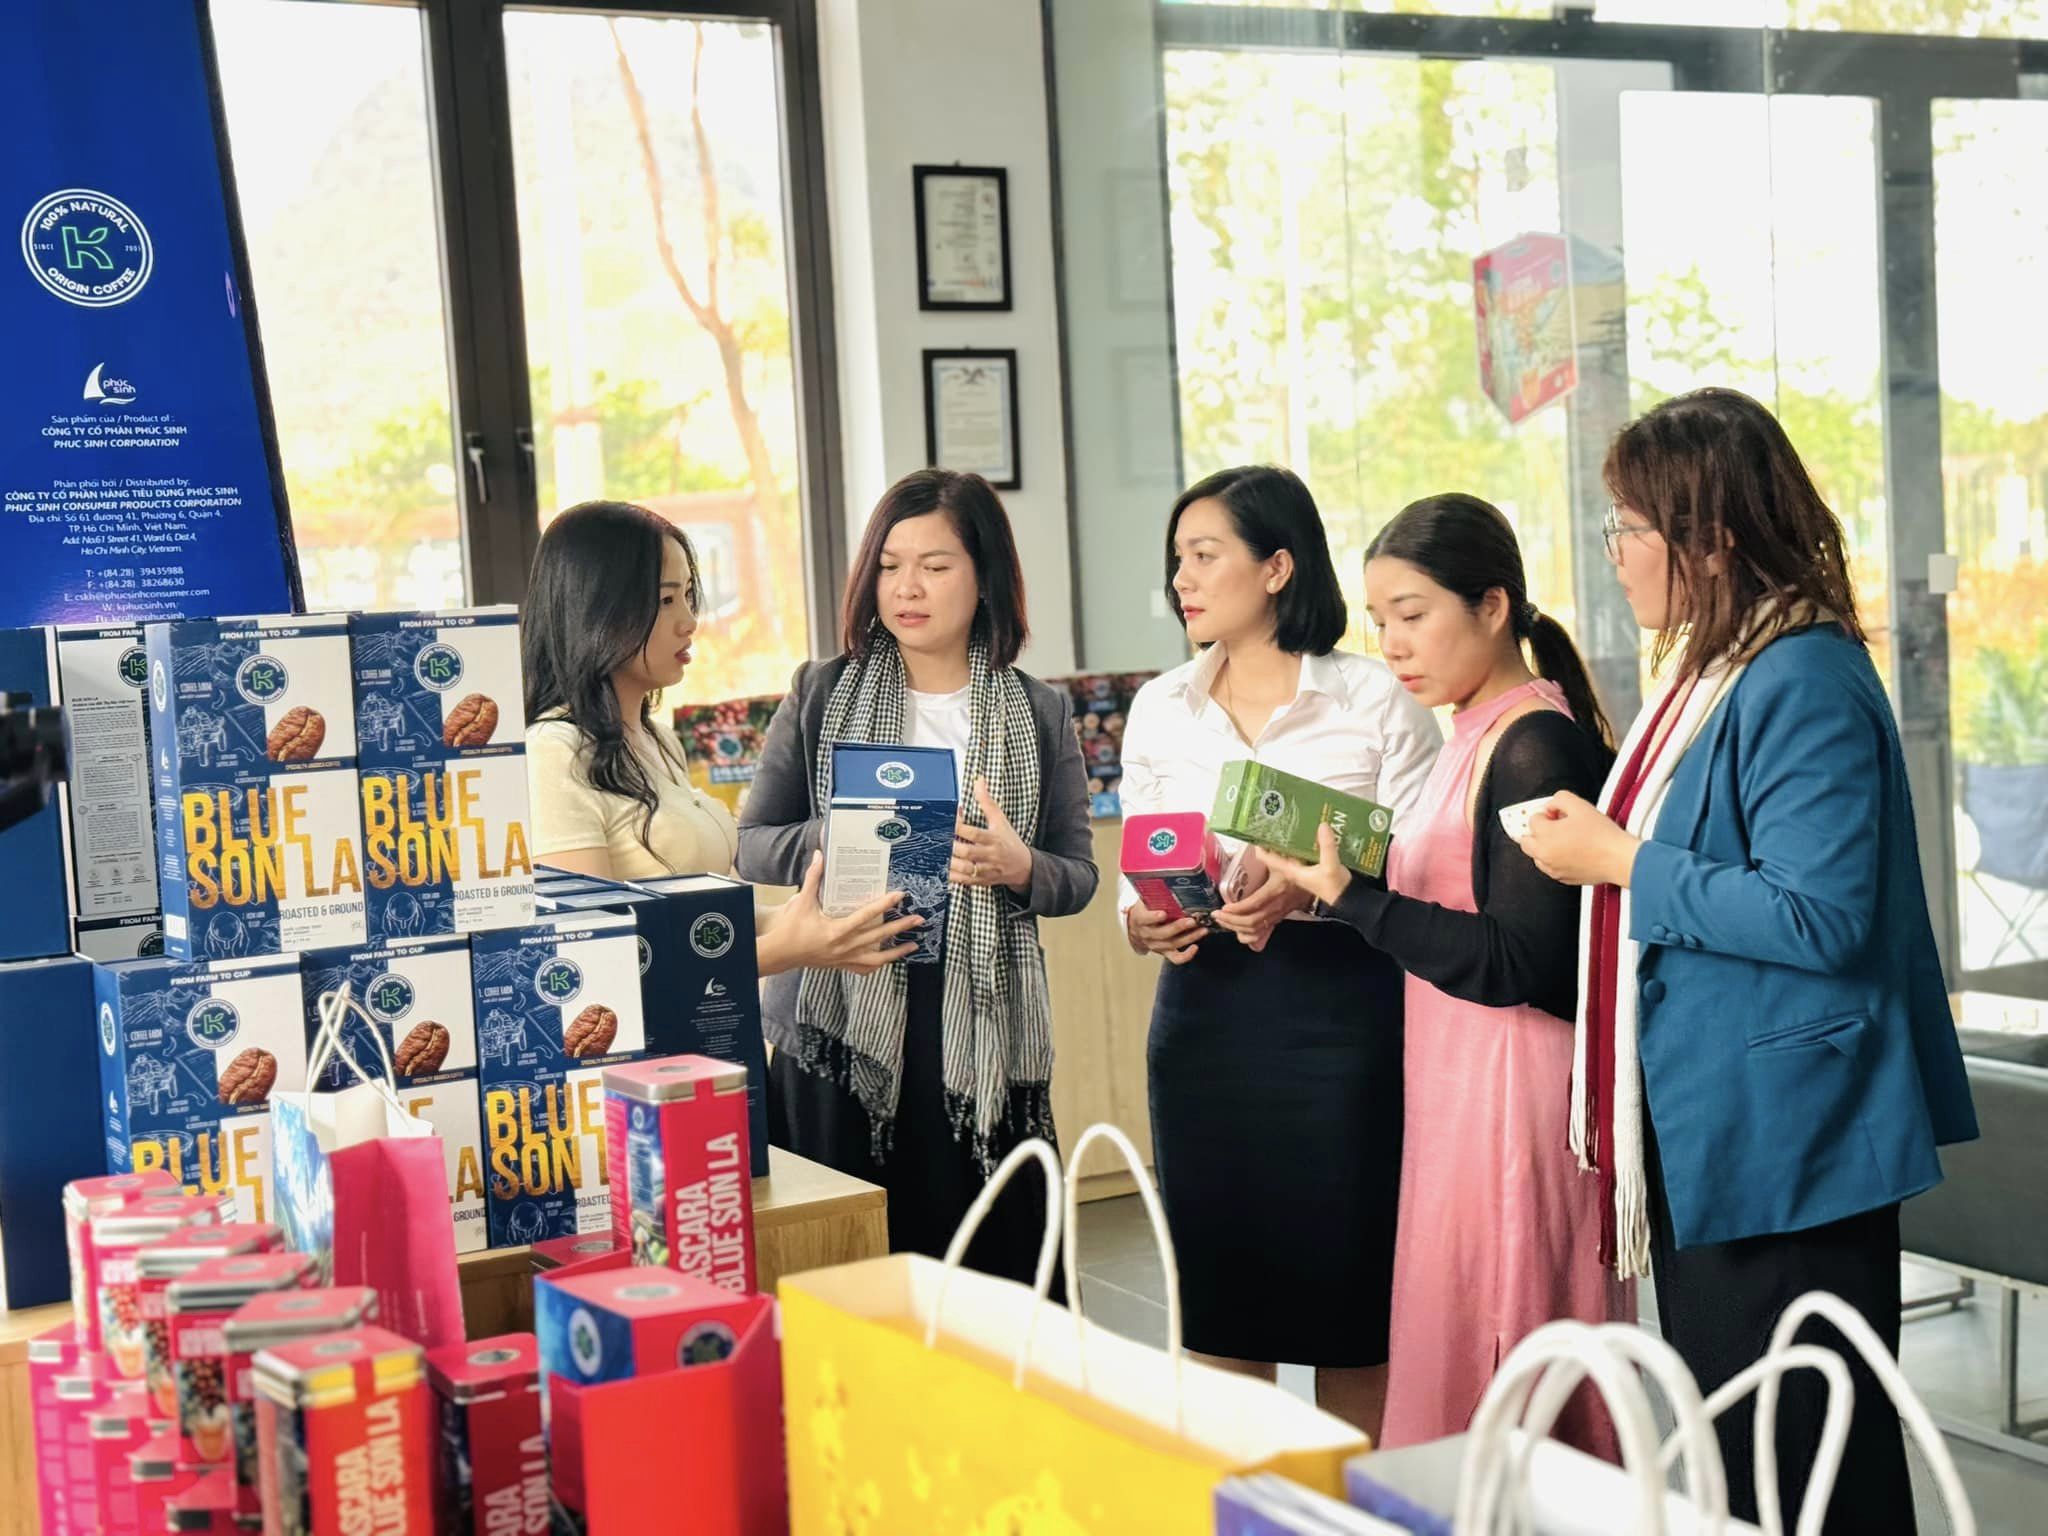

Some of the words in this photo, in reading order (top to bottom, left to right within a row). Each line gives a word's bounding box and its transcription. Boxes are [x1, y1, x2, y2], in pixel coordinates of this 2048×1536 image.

[40, 204, 69, 231] 100%
[70, 201, 129, 234] NATURAL
[48, 267, 90, 295] ORIGIN
[93, 267, 136, 295] COFFEE
[103, 378, 128, 390] phúc
[113, 384, 136, 393] sinh
[123, 414, 158, 424] Product
[41, 425, 71, 437] CÔNG
[73, 426, 86, 436] TY
[163, 425, 187, 435] SINH
[54, 439, 81, 449] PHUC
[83, 439, 108, 449] SINH
[110, 437, 179, 448] CORPORATION
[125, 478, 174, 487] Distributed
[5, 490, 35, 501] CÔNG
[37, 491, 50, 500] TY
[215, 486, 238, 496] SINH
[4, 503, 34, 512] PHUC
[35, 503, 60, 512] SINH
[62, 501, 118, 511] CONSUMER
[119, 499, 172, 510] PRODUCTS
[173, 497, 242, 508] CORPORATION
[79, 512, 91, 522] 61
[86, 569, 94, 578] T:
[87, 581, 96, 590] F:
[399, 620, 422, 629] FROM
[423, 619, 444, 627] FARM
[445, 618, 457, 626] TO
[458, 617, 474, 626] CUP
[122, 629, 143, 637] FARM
[220, 632, 243, 641] FROM
[244, 631, 267, 640] FARM
[269, 630, 281, 638] TO
[282, 629, 299, 638] CUP
[362, 770, 482, 836] BLUE
[182, 785, 310, 853] BLUE
[367, 827, 461, 889] SON
[475, 819, 533, 880] LA
[187, 844, 287, 909] SON
[301, 834, 362, 898] LA
[454, 887, 490, 901] ROASTED
[492, 887, 498, 898] &
[501, 884, 534, 898] GROUND
[280, 906, 319, 920] ROASTED
[321, 904, 327, 916] &
[329, 901, 364, 916] GROUND
[520, 936, 542, 945] FROM
[543, 934, 564, 943] FARM
[565, 933, 577, 941] TO
[577, 931, 594, 940] CUP
[351, 952, 373, 961] FROM
[374, 950, 395, 959] FARM
[396, 948, 407, 957] TO
[408, 946, 425, 955] CUP
[170, 976, 195, 985] FROM
[196, 973, 218, 983] FARM
[220, 972, 232, 980] TO
[233, 970, 251, 979] CUP
[486, 1079, 603, 1148] BLUE
[706, 1133, 739, 1169] LA
[131, 1126, 263, 1192] BLUE
[491, 1135, 583, 1200] SON
[710, 1172, 743, 1226] SON
[453, 1207, 486, 1222] GROUND
[710, 1228, 747, 1293] BLUE
[365, 1397, 400, 1434] LA
[367, 1434, 404, 1490] SON
[334, 1445, 373, 1536] SCARA
